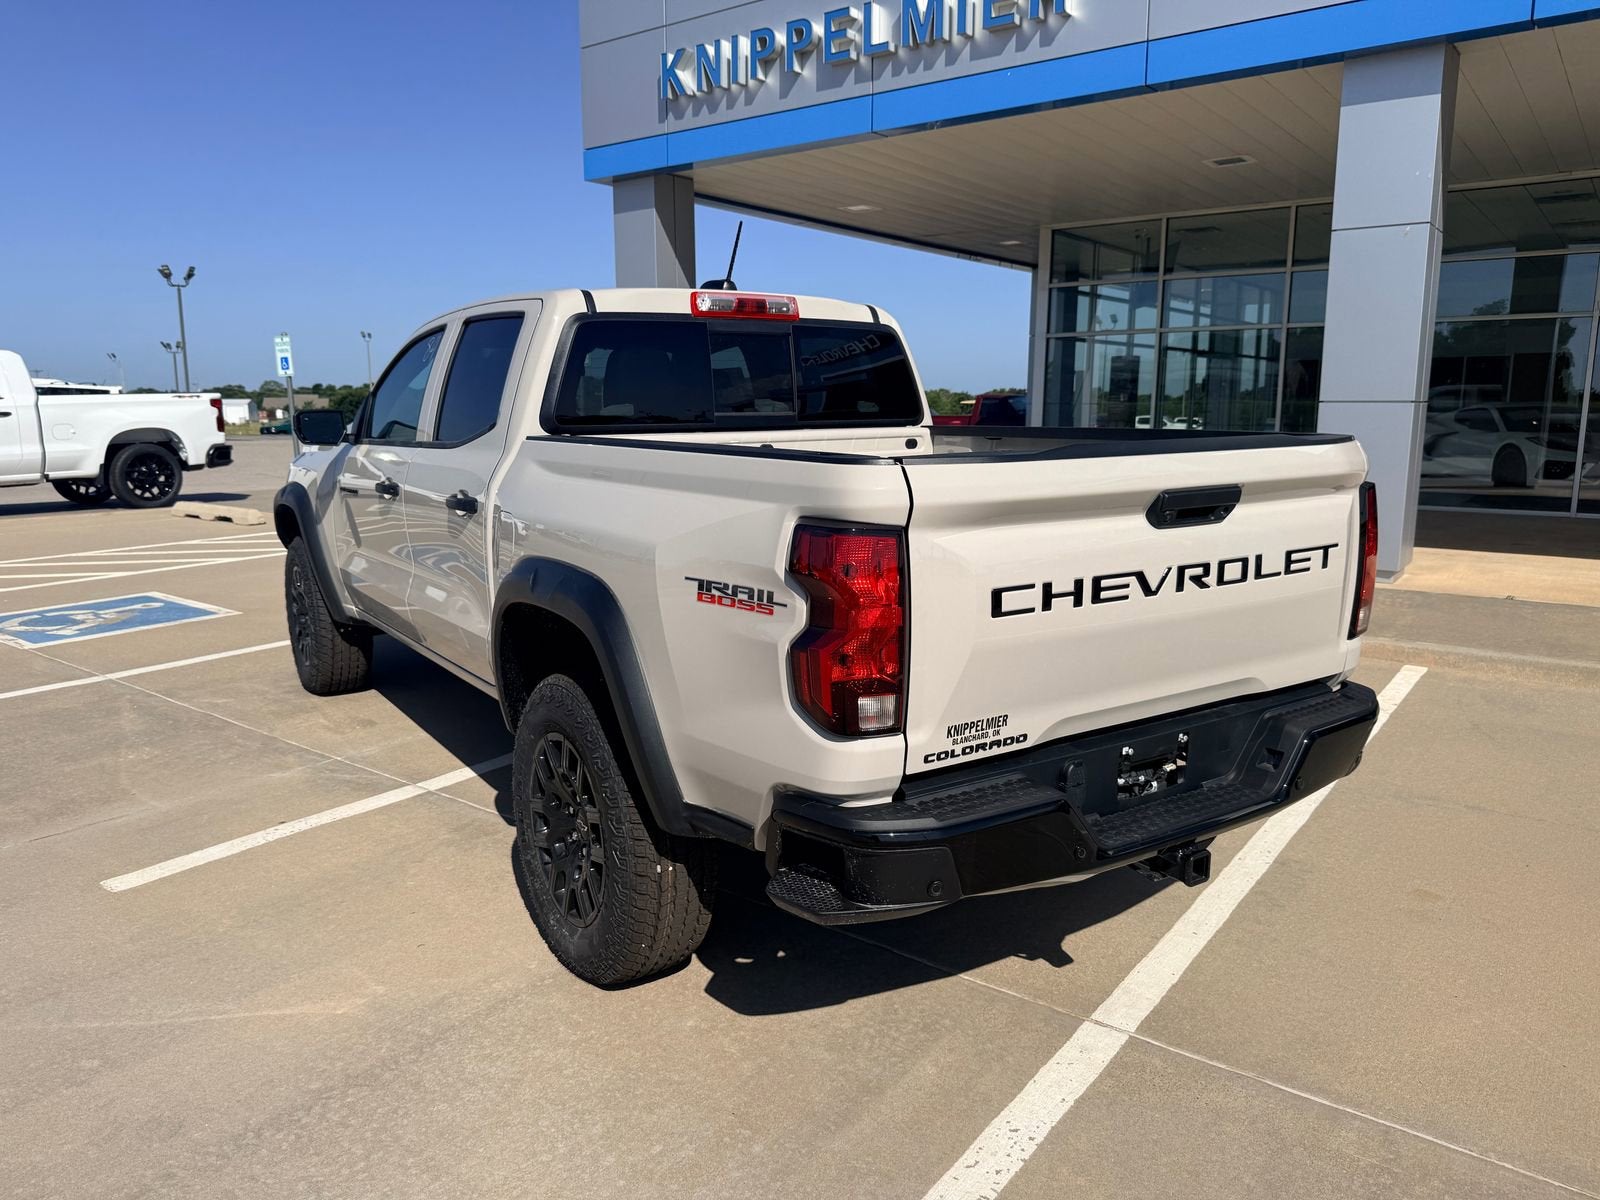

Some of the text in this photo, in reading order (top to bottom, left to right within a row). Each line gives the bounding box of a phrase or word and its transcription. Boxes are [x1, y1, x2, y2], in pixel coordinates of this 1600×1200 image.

[660, 0, 1069, 99] KNIPPELMI
[684, 576, 787, 608] TRAIL
[991, 543, 1339, 618] CHEVROLET
[697, 591, 774, 616] BOSS
[946, 714, 1009, 739] KNIPPELMIER
[951, 728, 1001, 746] BLANCHARD, OK
[923, 733, 1028, 764] COLORADO
